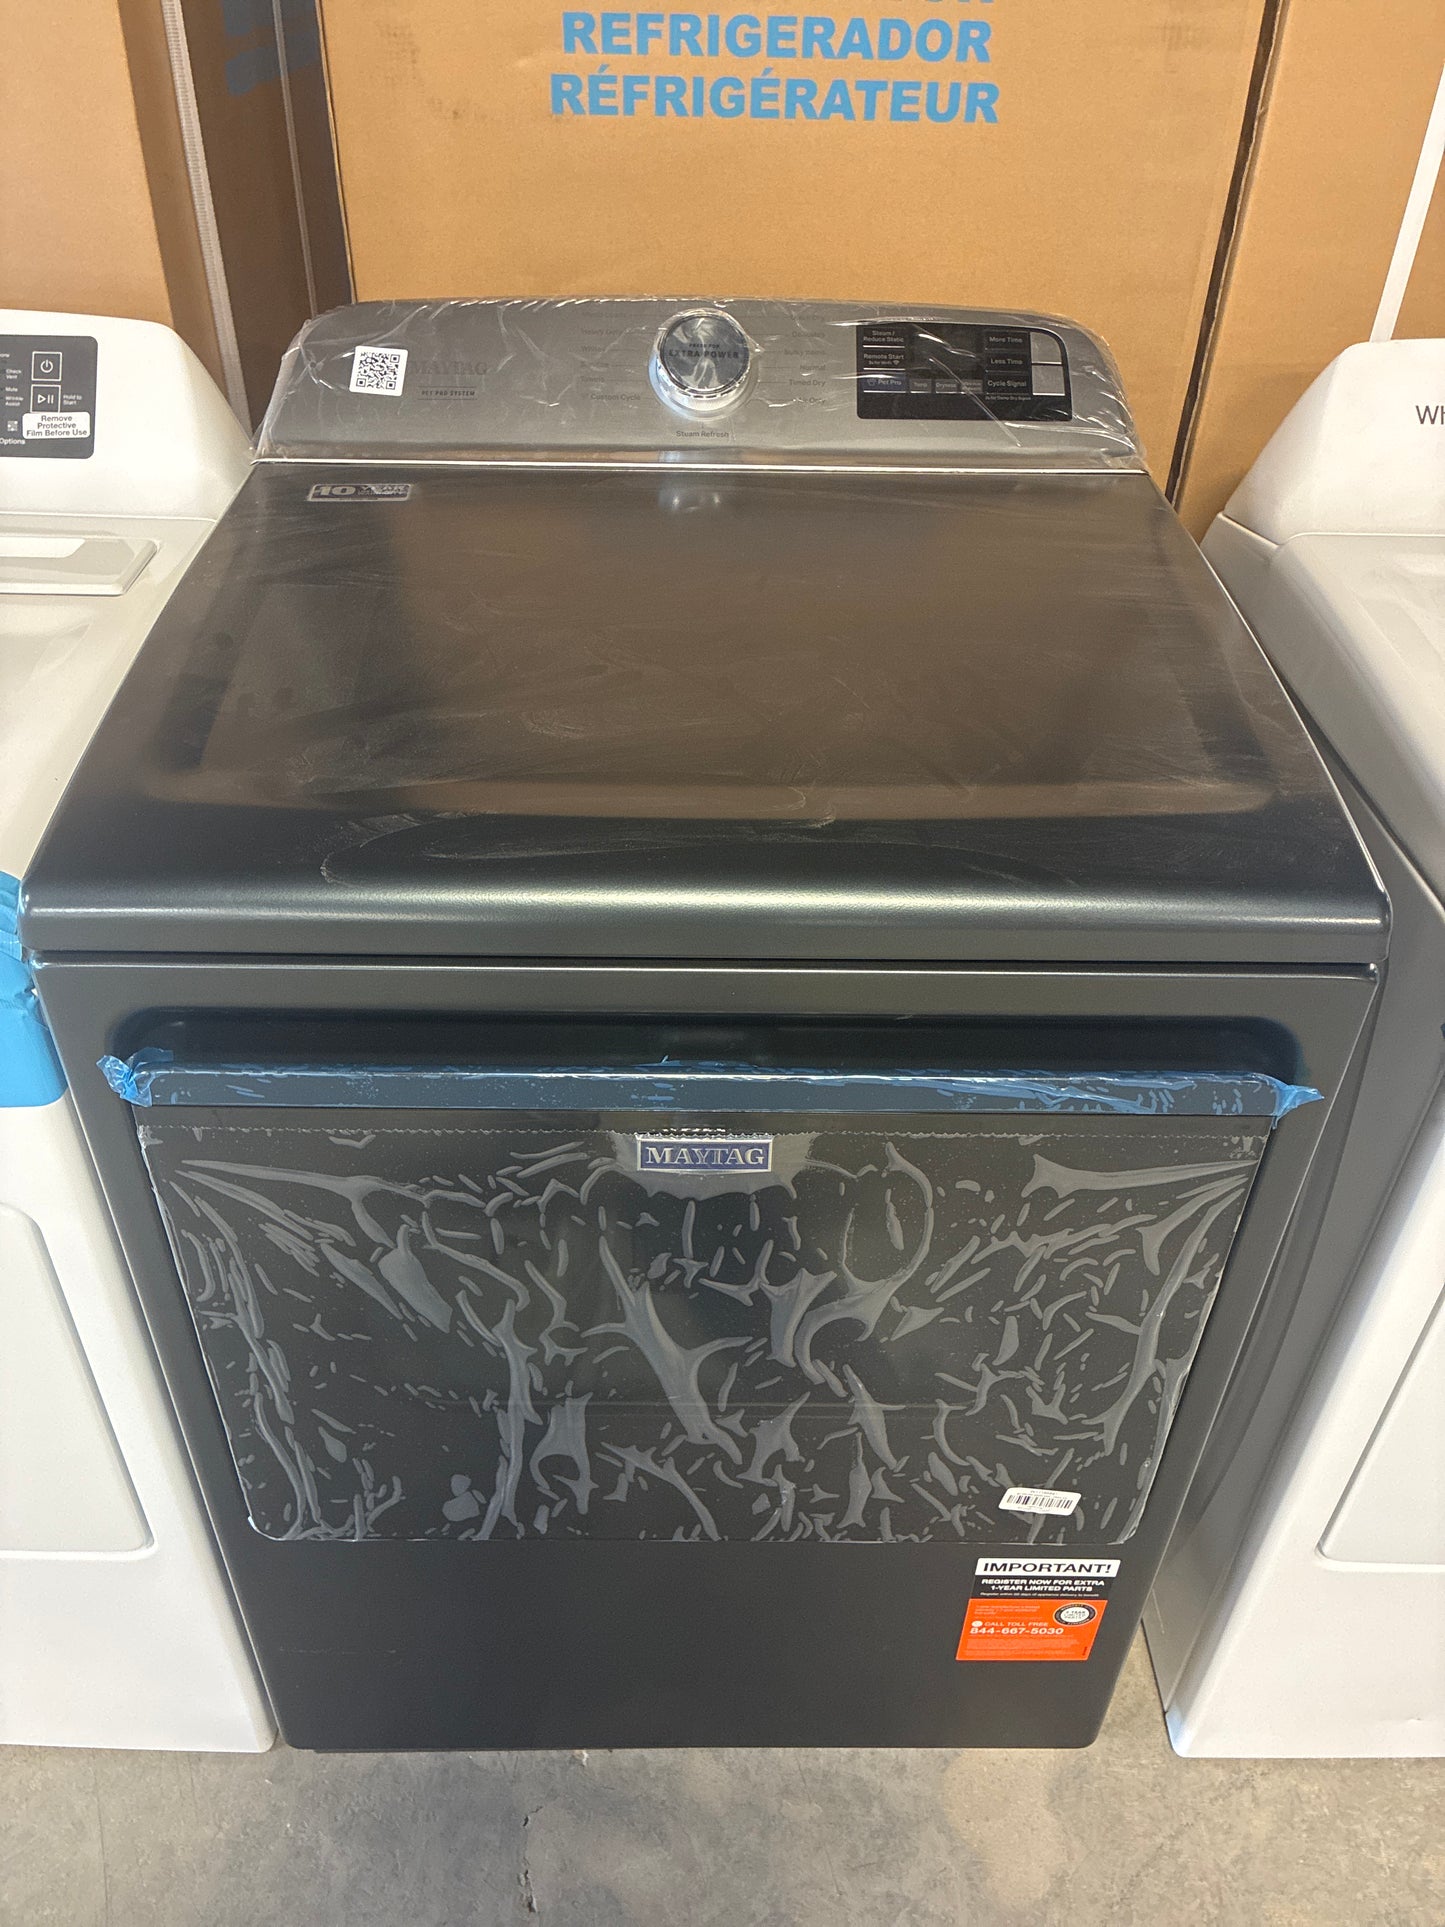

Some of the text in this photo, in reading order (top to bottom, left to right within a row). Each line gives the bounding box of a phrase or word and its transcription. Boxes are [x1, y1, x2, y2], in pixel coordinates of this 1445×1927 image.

[562, 12, 991, 62] REFRIGERADOR
[550, 64, 1000, 124] RÉFRIGÉRATEUR
[812, 379, 826, 387] Dry
[1007, 380, 1027, 388] Signal
[620, 393, 641, 402] Cycle
[45, 429, 71, 437] Before
[72, 428, 87, 436] Use
[676, 430, 729, 438] Steam Refresh
[0, 438, 26, 446] Options
[315, 486, 355, 496] 10
[645, 1147, 765, 1165] MAYTAG
[983, 1562, 1112, 1573] IMPORTANT!
[969, 1627, 1064, 1635] 844-667-5030
